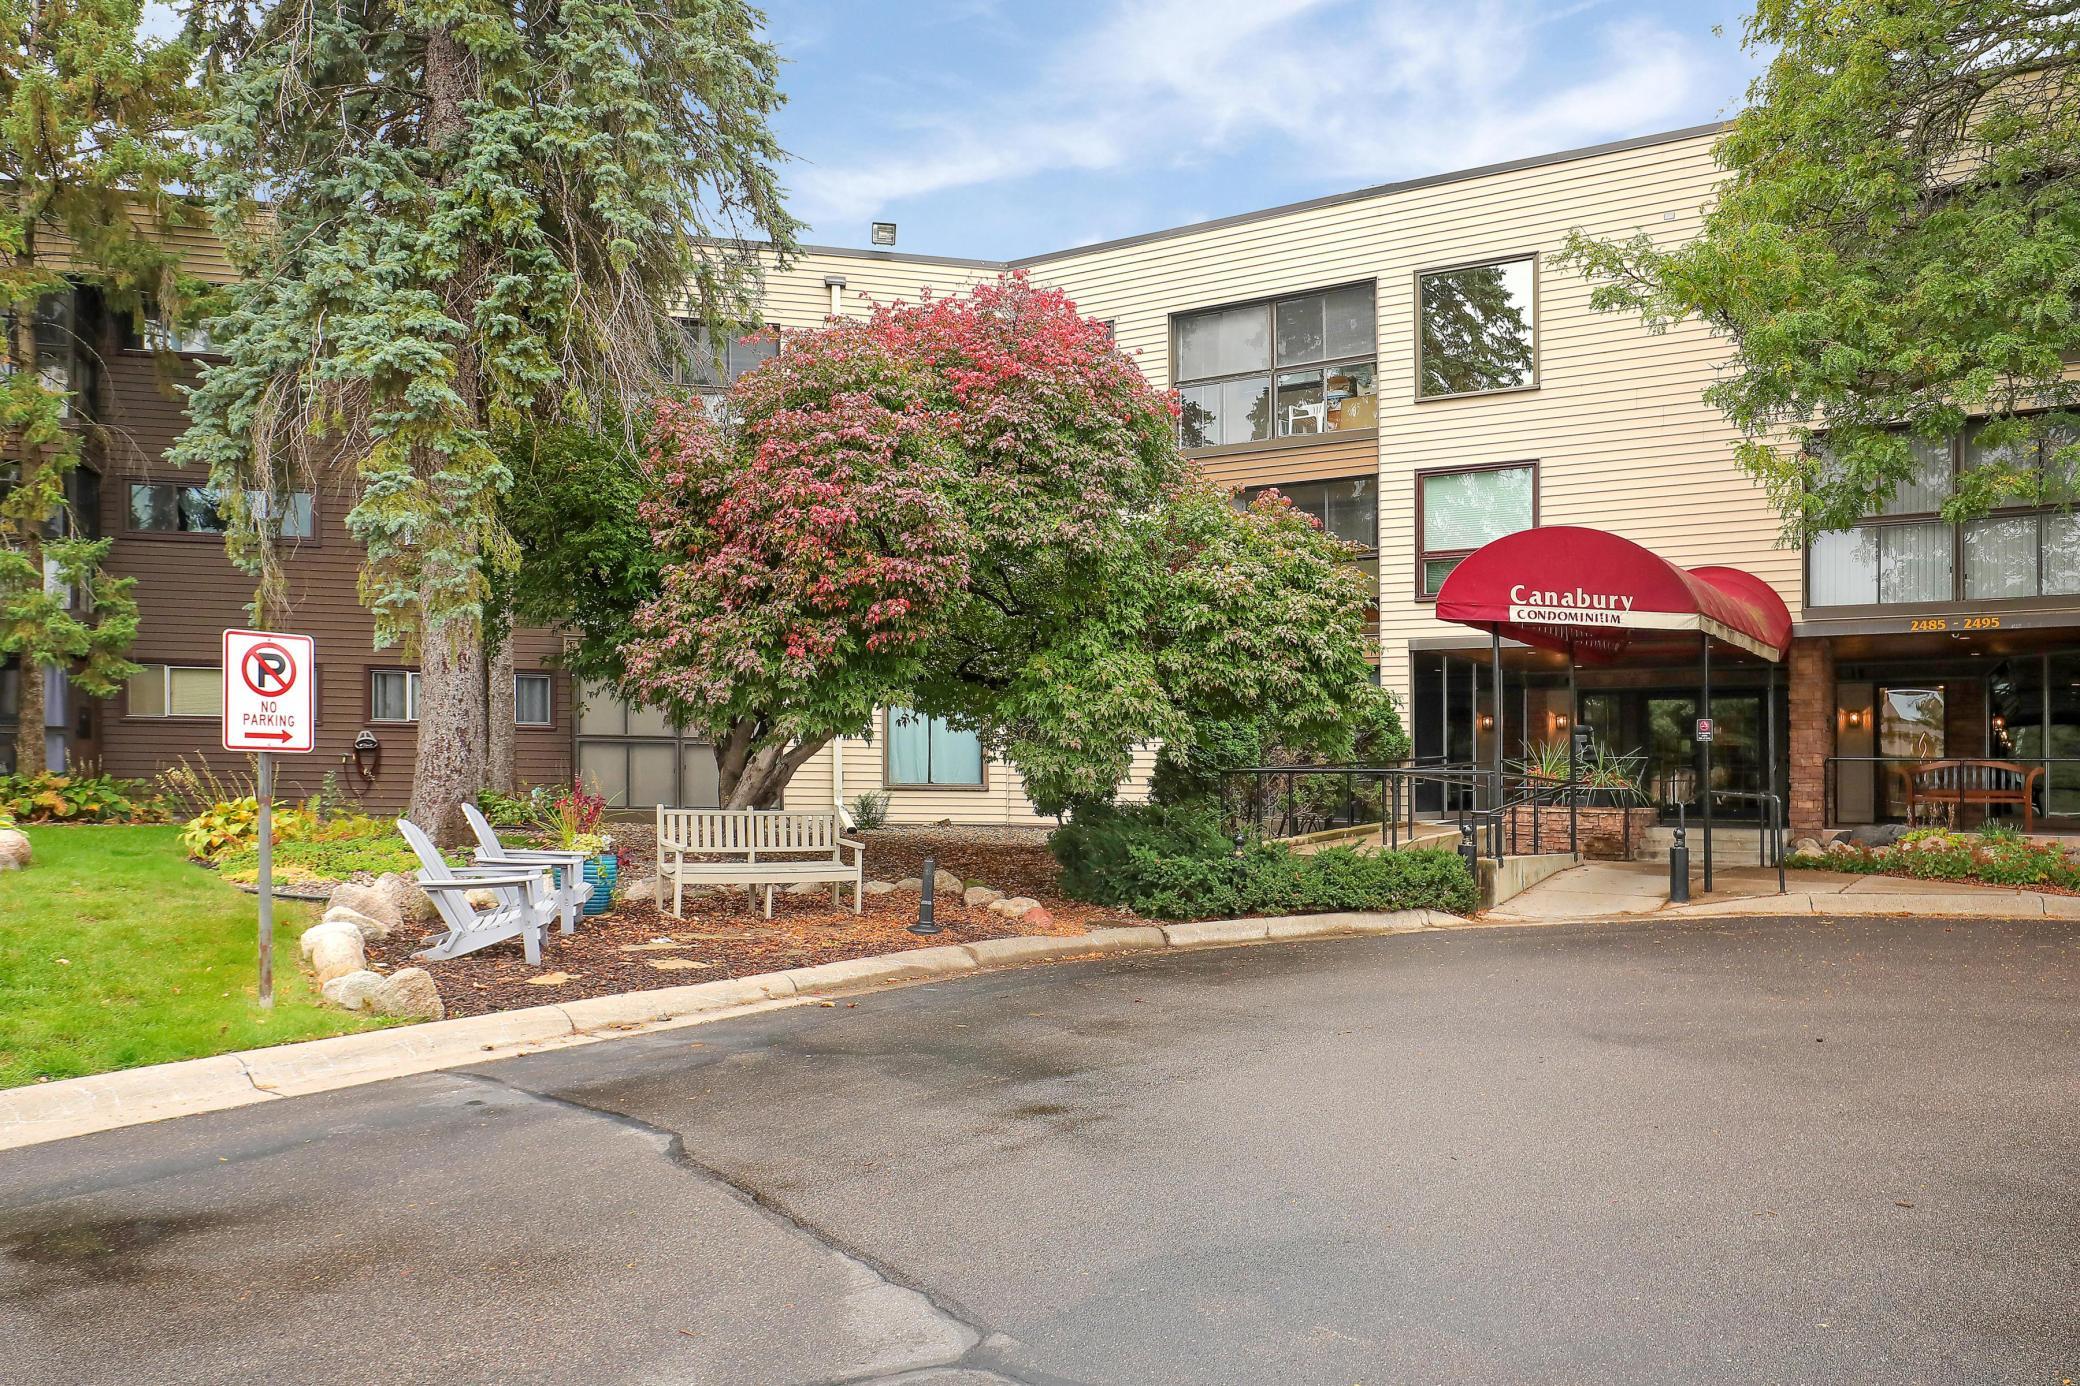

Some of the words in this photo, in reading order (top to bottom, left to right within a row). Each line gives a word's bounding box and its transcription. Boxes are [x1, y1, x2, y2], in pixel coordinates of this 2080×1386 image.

[1510, 584, 1633, 613] Canabury
[1911, 619, 1946, 631] 2485
[1963, 617, 2000, 629] 2495
[261, 701, 277, 713] NO
[243, 713, 295, 727] PARKING
